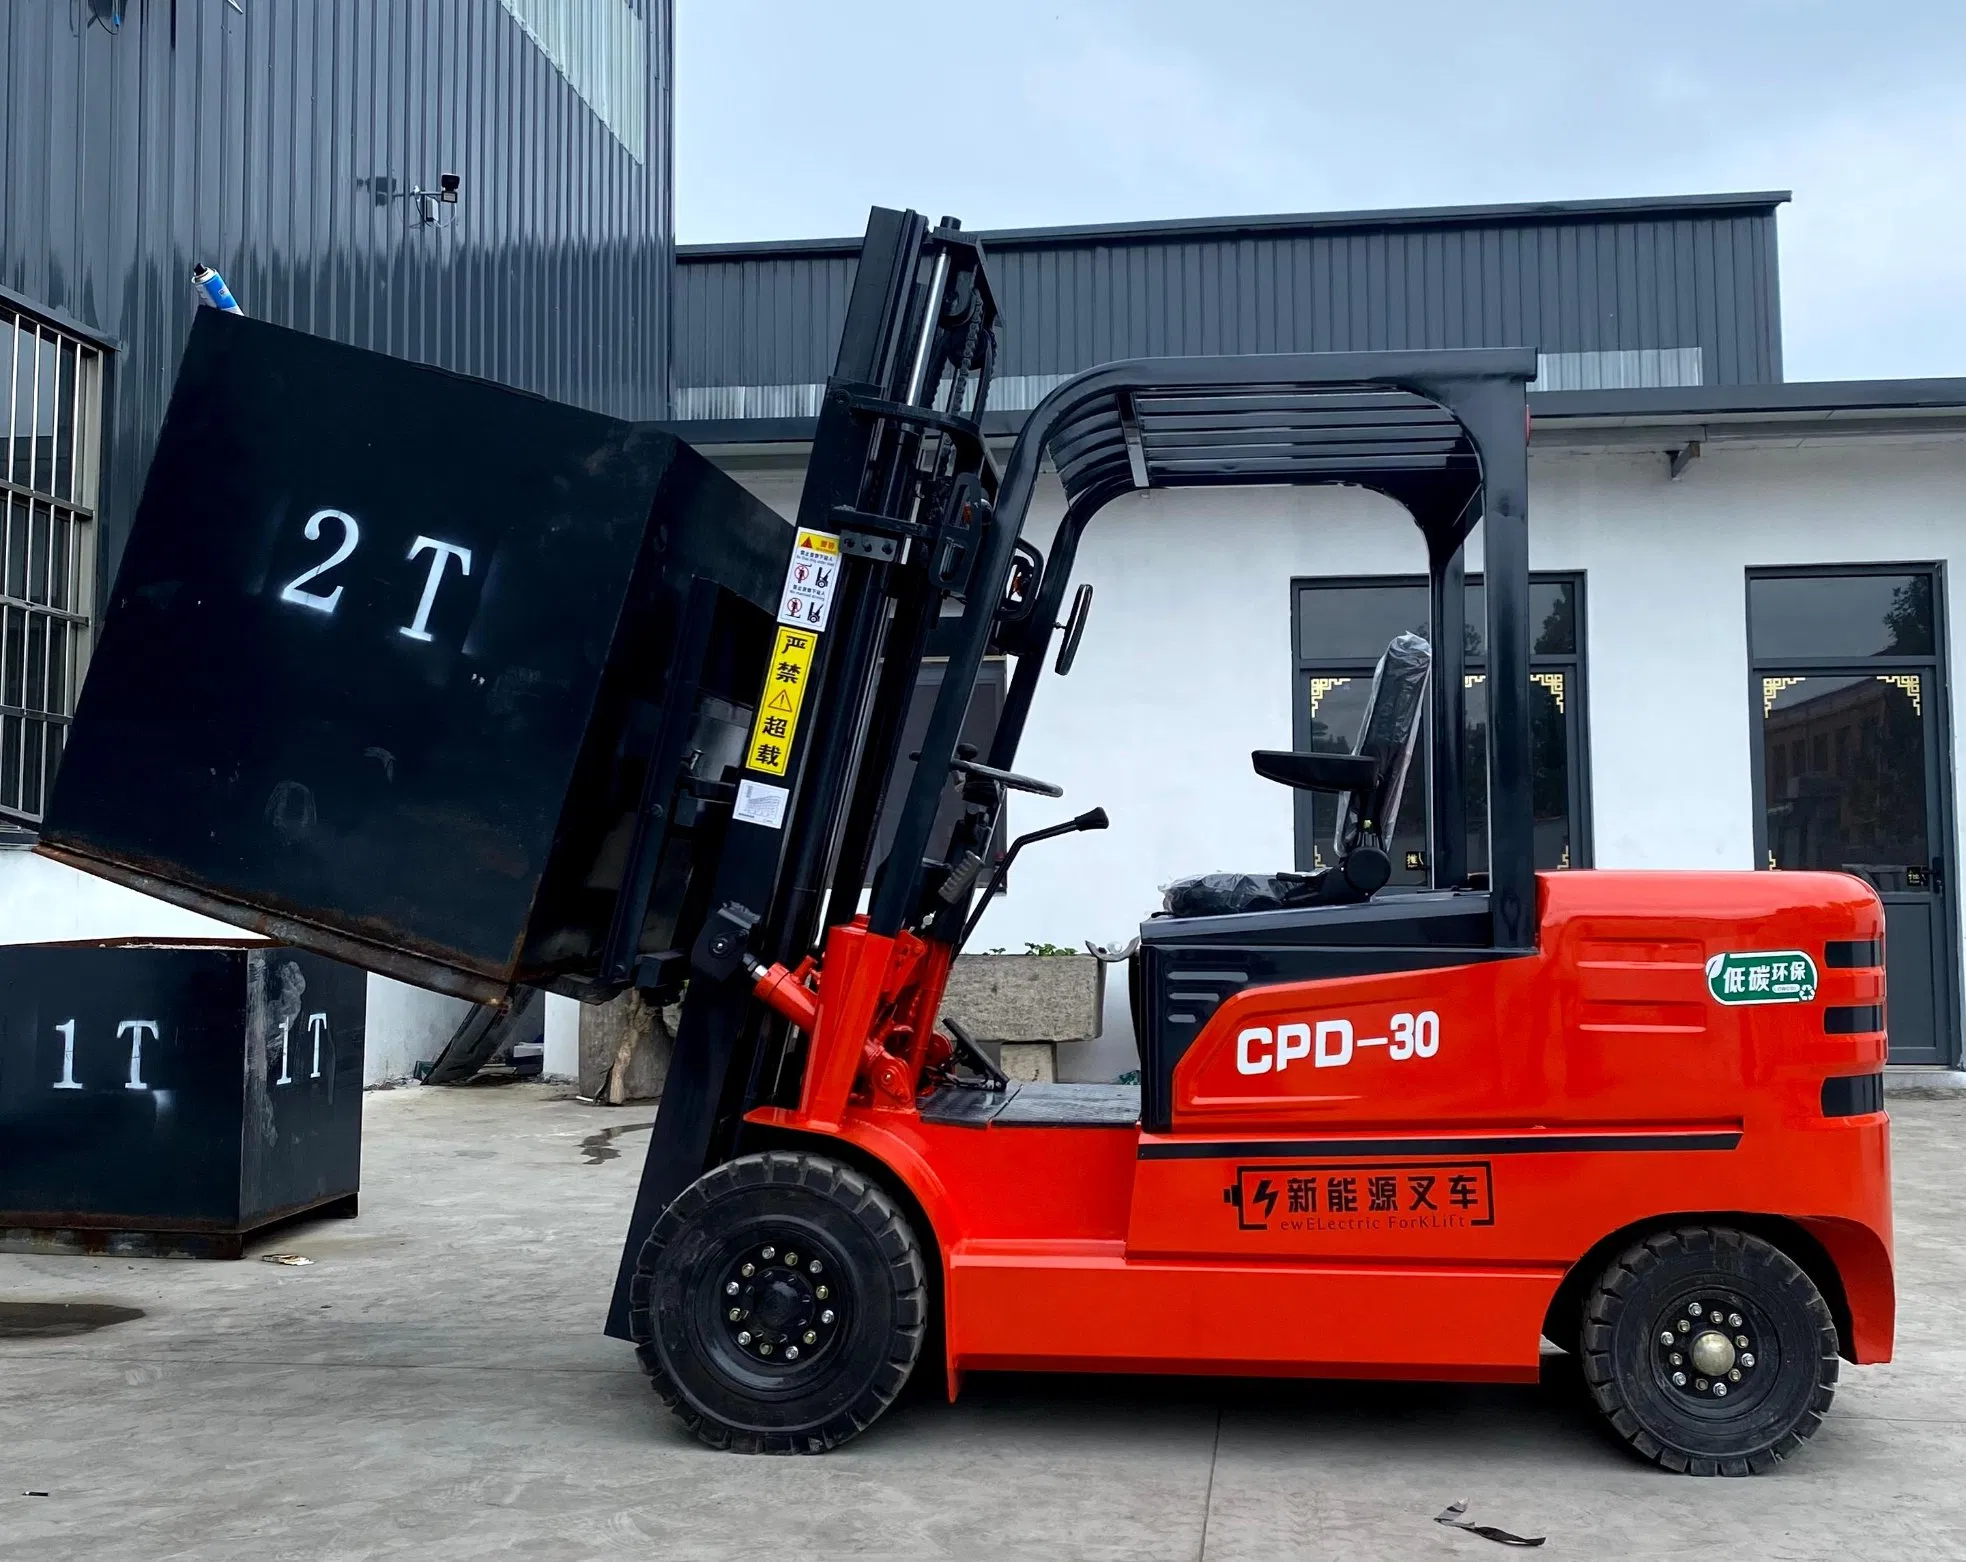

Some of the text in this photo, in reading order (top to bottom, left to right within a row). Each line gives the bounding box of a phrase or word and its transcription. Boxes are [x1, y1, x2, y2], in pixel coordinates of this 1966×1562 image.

[280, 509, 472, 642] 2 T
[1723, 961, 1806, 994] 低碳环保
[53, 1019, 160, 1090] 1 T
[276, 1012, 328, 1085] 1 T
[1236, 1010, 1440, 1075] CPD-30
[1287, 1174, 1479, 1213] 新能源叉车
